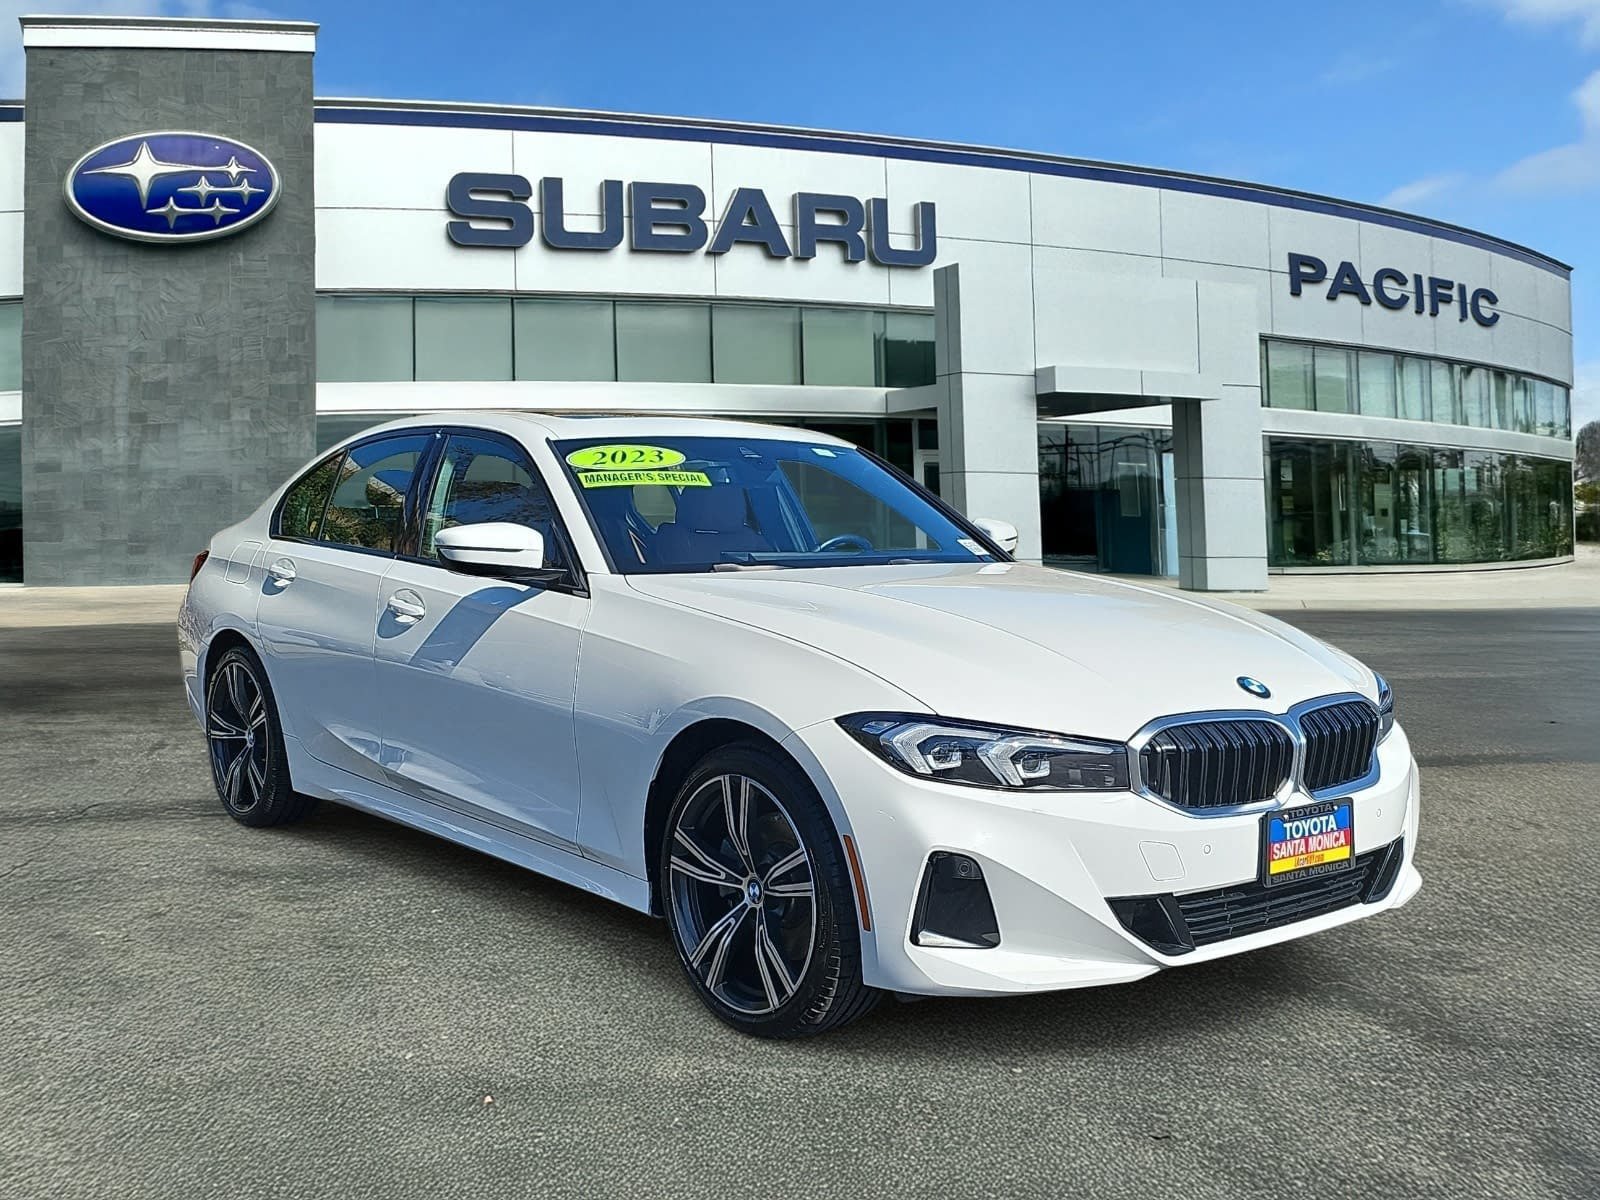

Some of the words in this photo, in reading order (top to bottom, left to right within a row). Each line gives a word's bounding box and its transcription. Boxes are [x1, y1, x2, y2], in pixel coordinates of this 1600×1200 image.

[447, 172, 937, 267] SUBARU
[1288, 252, 1500, 327] PACIFIC
[592, 449, 664, 465] 2023
[585, 472, 654, 484] MANAGER'S
[659, 471, 704, 482] SPECIAL
[1289, 803, 1333, 818] TOYOTA
[1283, 814, 1337, 840] TOYOTA
[1273, 838, 1306, 859] SANTA
[1308, 831, 1346, 853] MONICA
[1272, 870, 1307, 883] SANTA
[1308, 861, 1350, 876] MONICA
